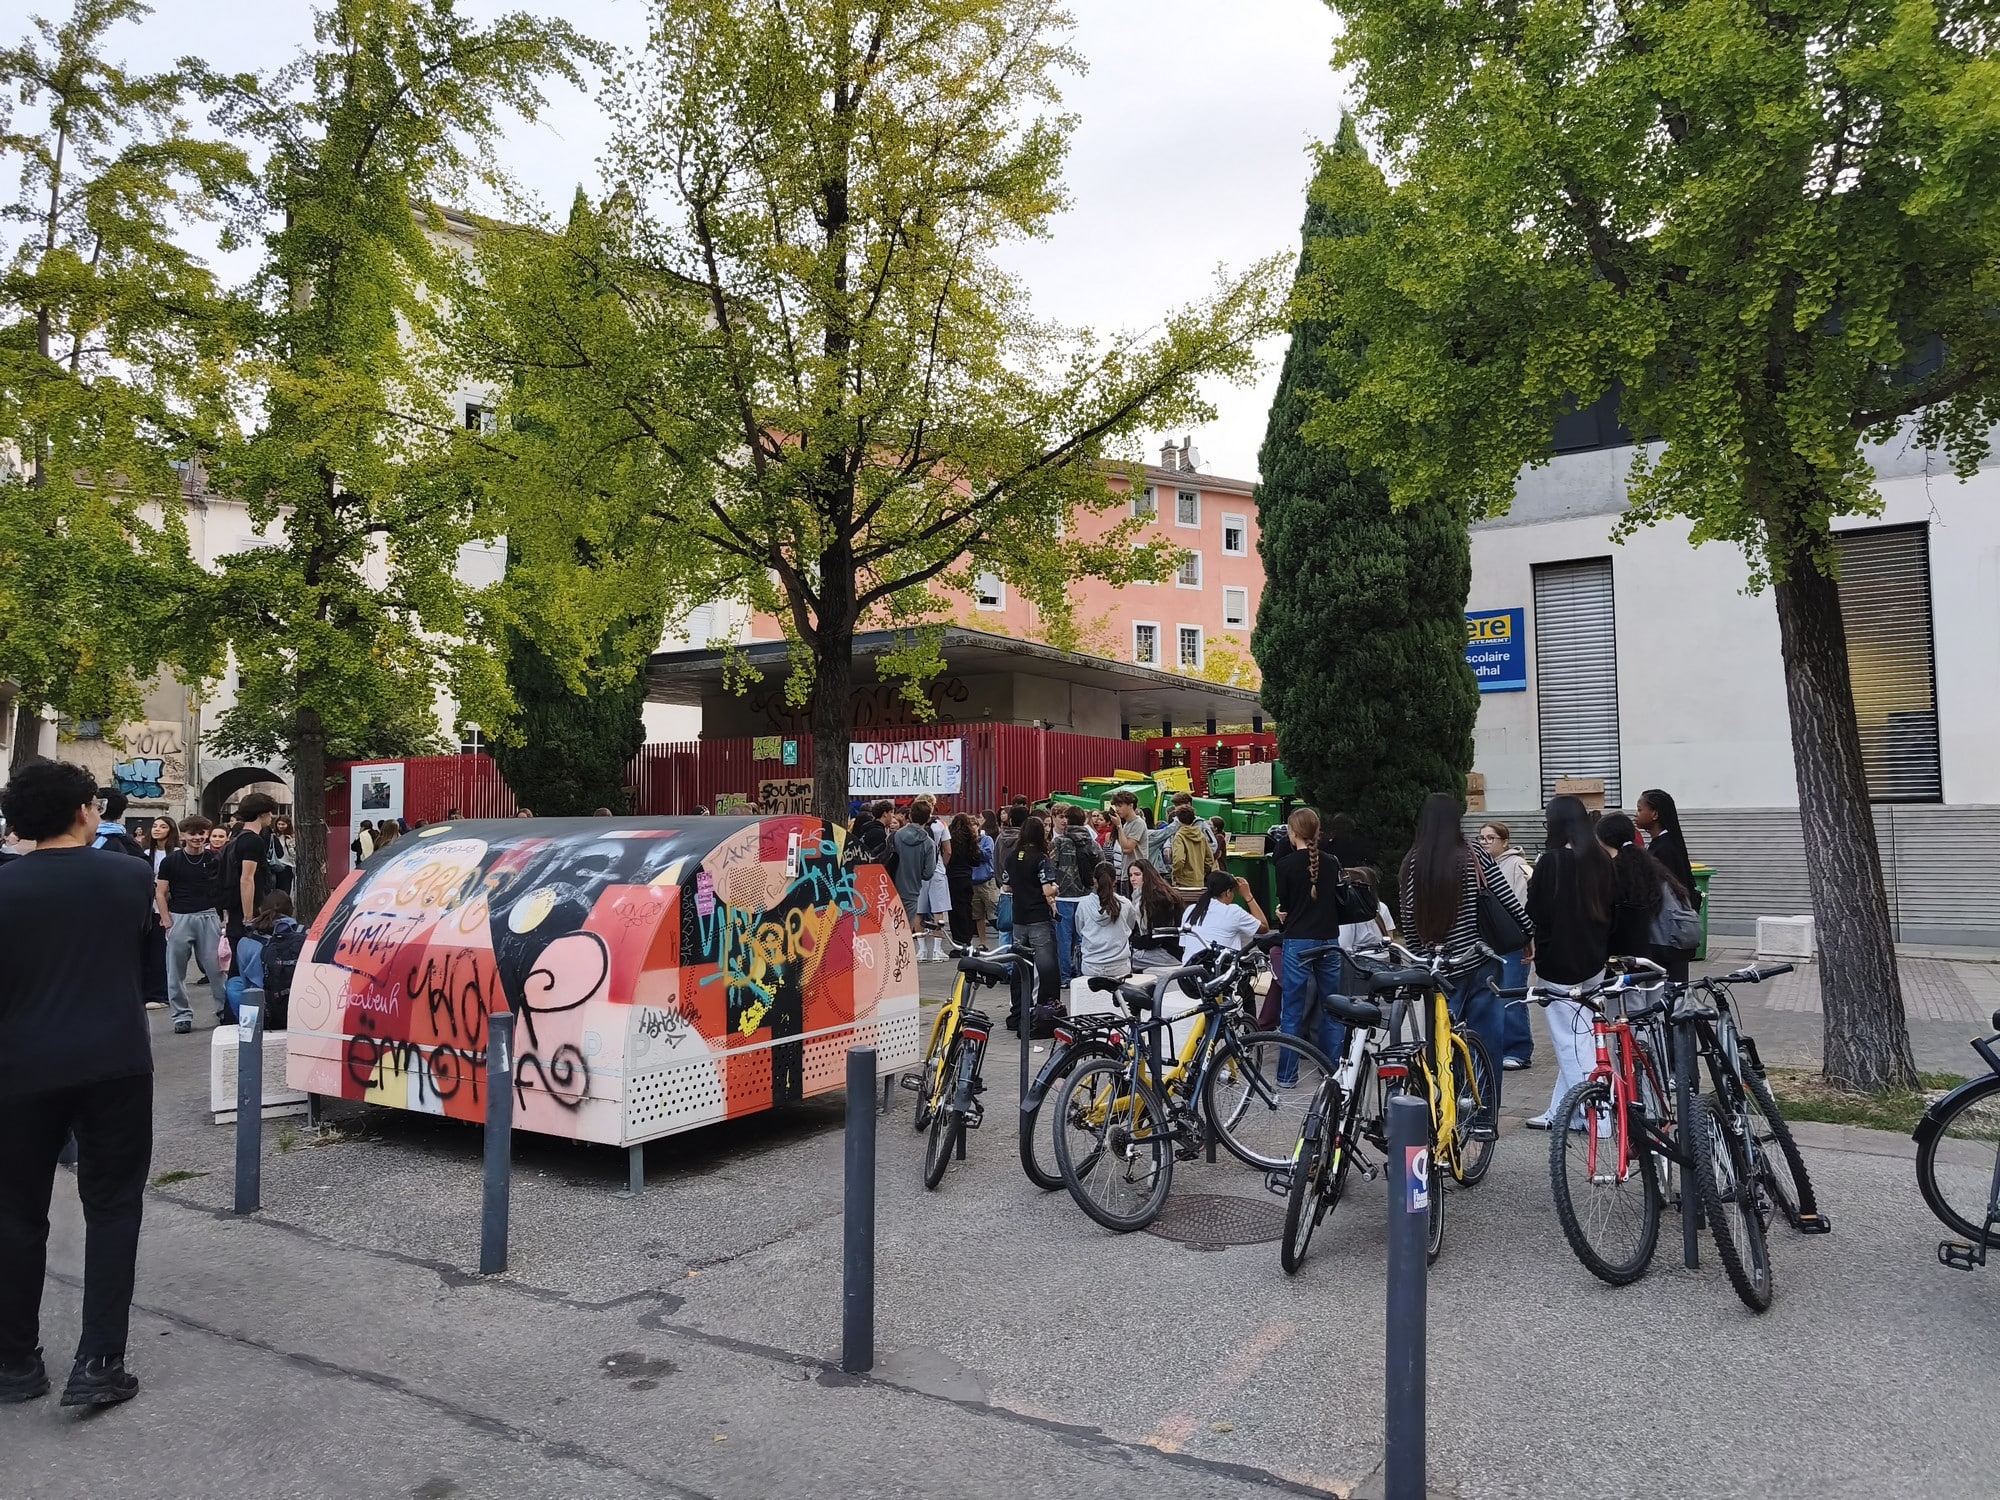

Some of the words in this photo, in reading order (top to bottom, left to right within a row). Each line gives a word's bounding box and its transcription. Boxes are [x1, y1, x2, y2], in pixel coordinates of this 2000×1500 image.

[1465, 651, 1510, 664] scolaire
[1473, 664, 1500, 676] dhal
[865, 740, 954, 765] CAPITALISME
[1202, 1038, 1216, 1072] SCOTT
